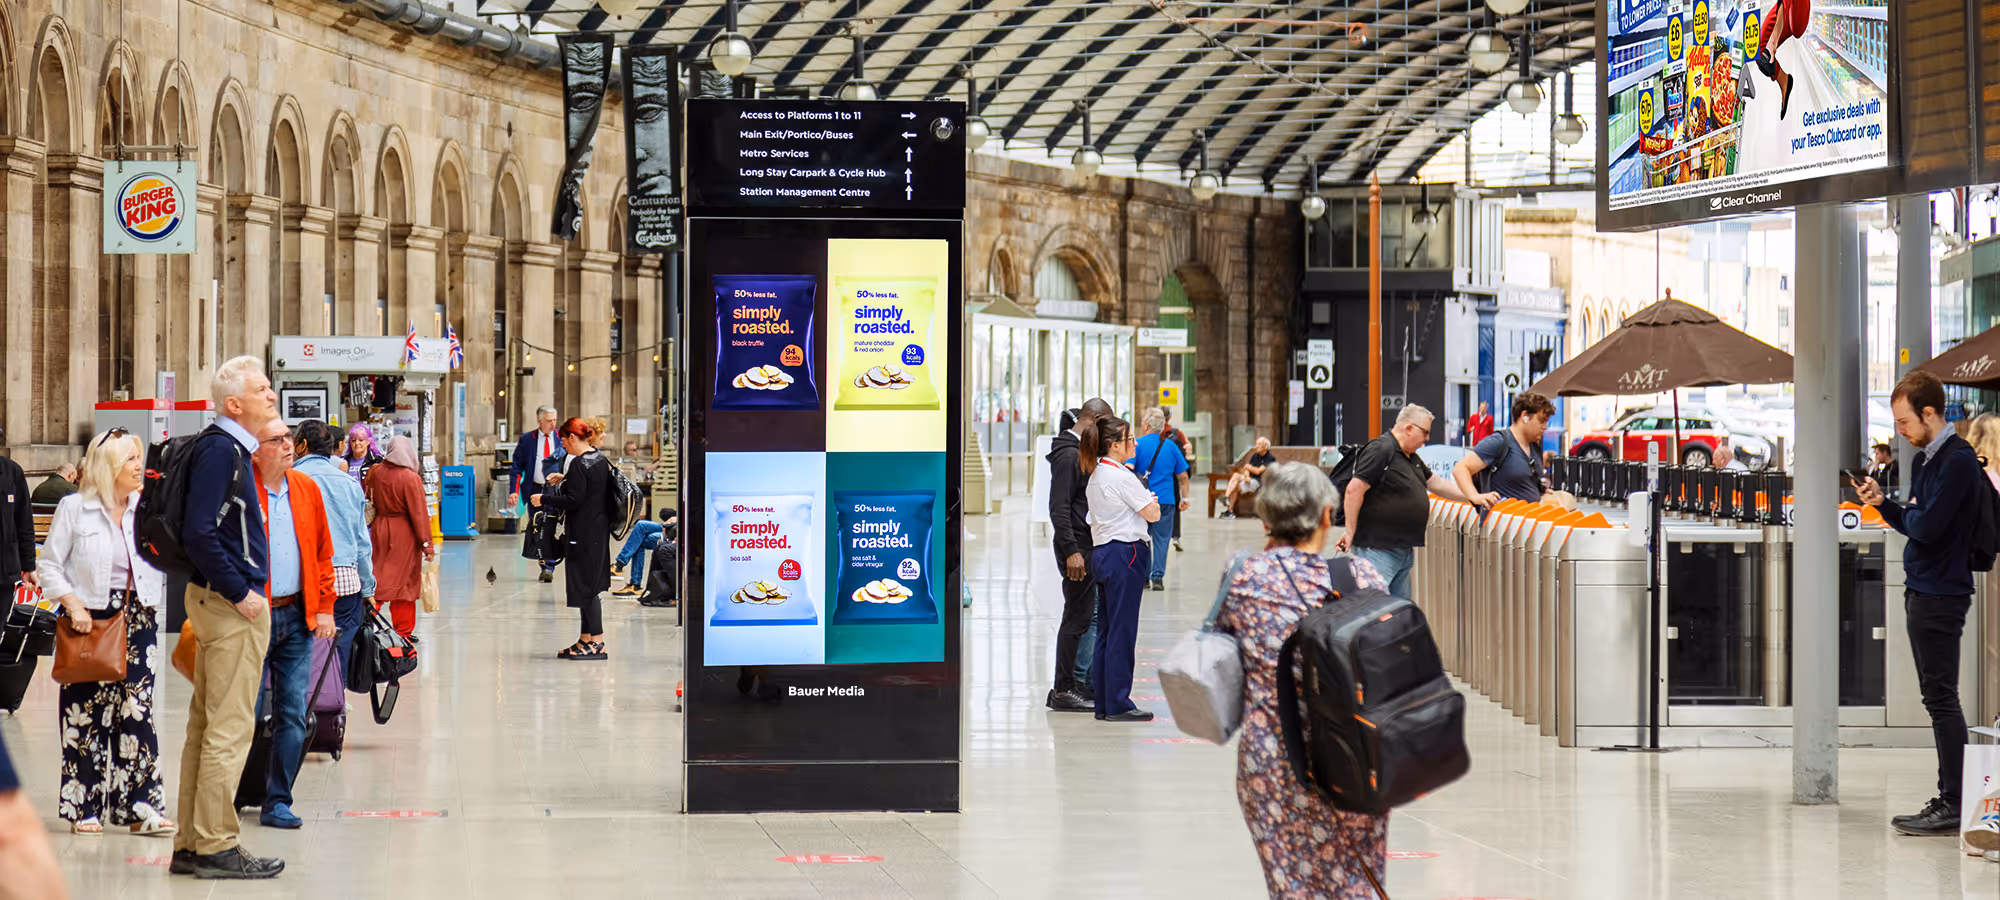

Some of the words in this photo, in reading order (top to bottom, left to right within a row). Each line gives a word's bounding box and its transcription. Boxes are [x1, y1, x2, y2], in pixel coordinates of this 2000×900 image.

[1629, 4, 1646, 26] LOWER
[1694, 12, 1708, 26] £2.50
[1670, 22, 1680, 42] £6
[1746, 24, 1758, 40] £1.75
[1640, 99, 1652, 117] 67p
[1802, 112, 1816, 127] Get
[1816, 104, 1846, 126] exclusive
[1846, 101, 1864, 118] deals
[1866, 98, 1881, 114] with
[740, 111, 772, 120] Access
[775, 112, 786, 120] to
[787, 111, 832, 120] Platforms
[834, 112, 839, 120] 1
[841, 112, 851, 120] to
[854, 112, 862, 120] 11
[740, 130, 762, 139] Main
[764, 130, 854, 140] Exit/Portico/Buses
[1791, 137, 1806, 154] your
[1806, 132, 1826, 148] Tesco
[1826, 124, 1857, 145] Clubcard
[1858, 128, 1866, 138] or
[1866, 124, 1882, 140] app.
[740, 150, 768, 158] Metro
[770, 150, 810, 158] Services
[740, 168, 764, 178] Long
[766, 168, 788, 178] Stay
[790, 168, 827, 178] Carpark
[829, 169, 836, 177] &
[838, 169, 864, 178] Cycle
[866, 169, 886, 177] Hub
[124, 186, 174, 212] BURGER
[740, 188, 772, 196] Station
[776, 188, 837, 198] Management
[838, 188, 871, 197] Centre
[1722, 196, 1744, 208] Clear
[1746, 189, 1782, 205] Channel
[628, 195, 680, 206] Centurion
[126, 198, 176, 228] KING
[630, 208, 656, 216] Probably
[667, 206, 680, 214] best
[654, 220, 673, 228] world.
[636, 229, 676, 247] Carlsberg
[734, 290, 752, 298] 50%
[856, 290, 874, 298] 50%
[732, 305, 782, 322] simply
[854, 305, 903, 321] simply
[732, 320, 794, 334] roasted.
[854, 320, 914, 334] roasted.
[320, 346, 352, 356] Images
[354, 346, 366, 354] On
[784, 348, 796, 356] 94
[906, 347, 916, 355] 93
[1618, 368, 1669, 385] AMT
[732, 504, 750, 512] 50%
[854, 504, 872, 512] 50%
[730, 520, 780, 536] simply
[852, 520, 900, 536] simply
[730, 534, 792, 549] roasted.
[852, 534, 913, 548] roasted.
[782, 562, 794, 570] 94
[788, 686, 825, 696] Bauer
[827, 686, 865, 696] Media
